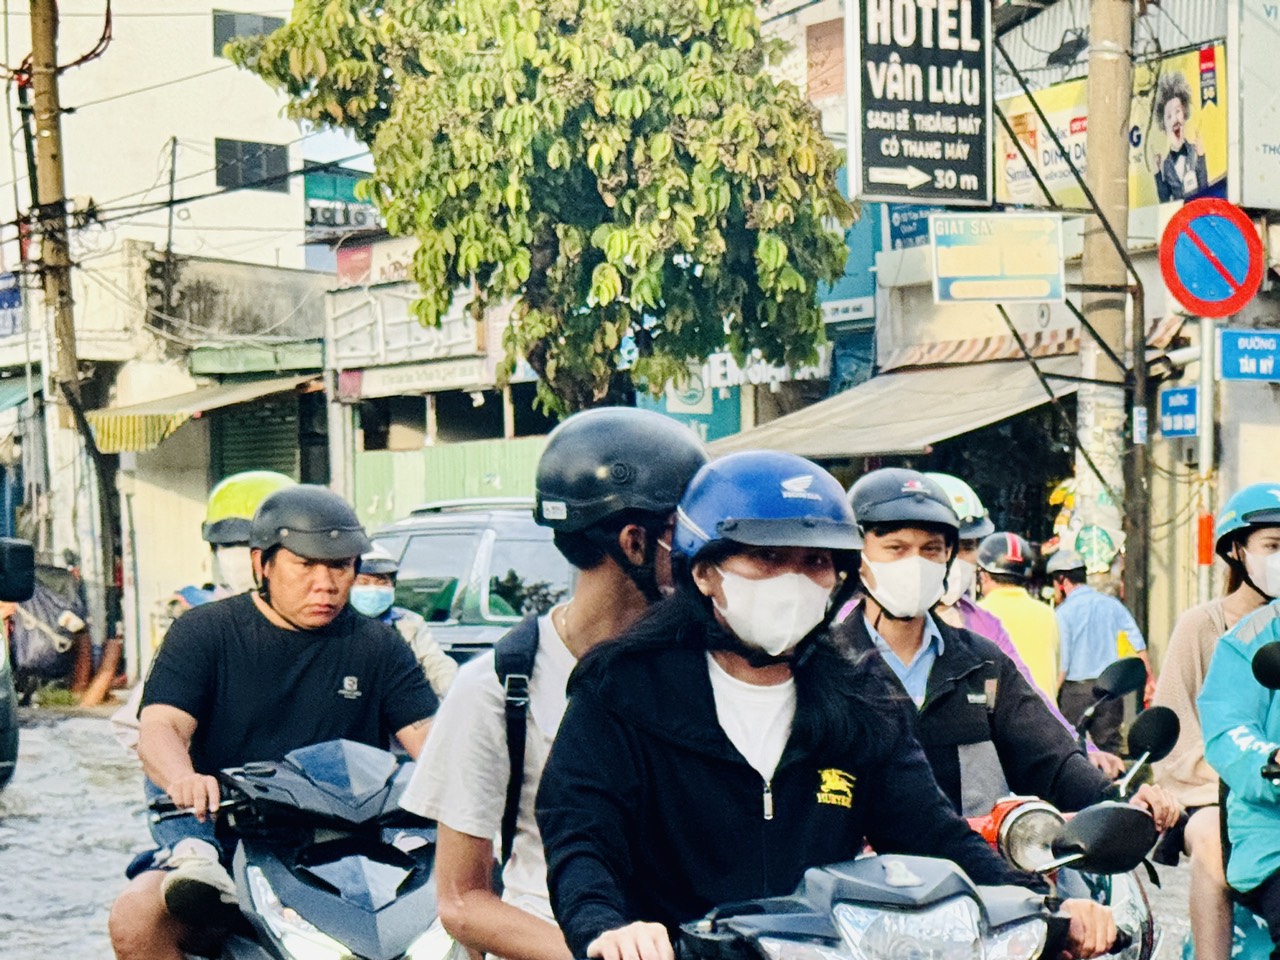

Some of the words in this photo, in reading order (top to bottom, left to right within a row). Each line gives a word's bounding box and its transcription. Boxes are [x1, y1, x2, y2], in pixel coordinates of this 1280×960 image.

[867, 0, 980, 52] HOTEL
[880, 135, 900, 157] CÓ
[901, 139, 942, 160] THANG
[945, 139, 970, 161] MÁY
[934, 169, 957, 190] 30
[960, 174, 978, 191] m
